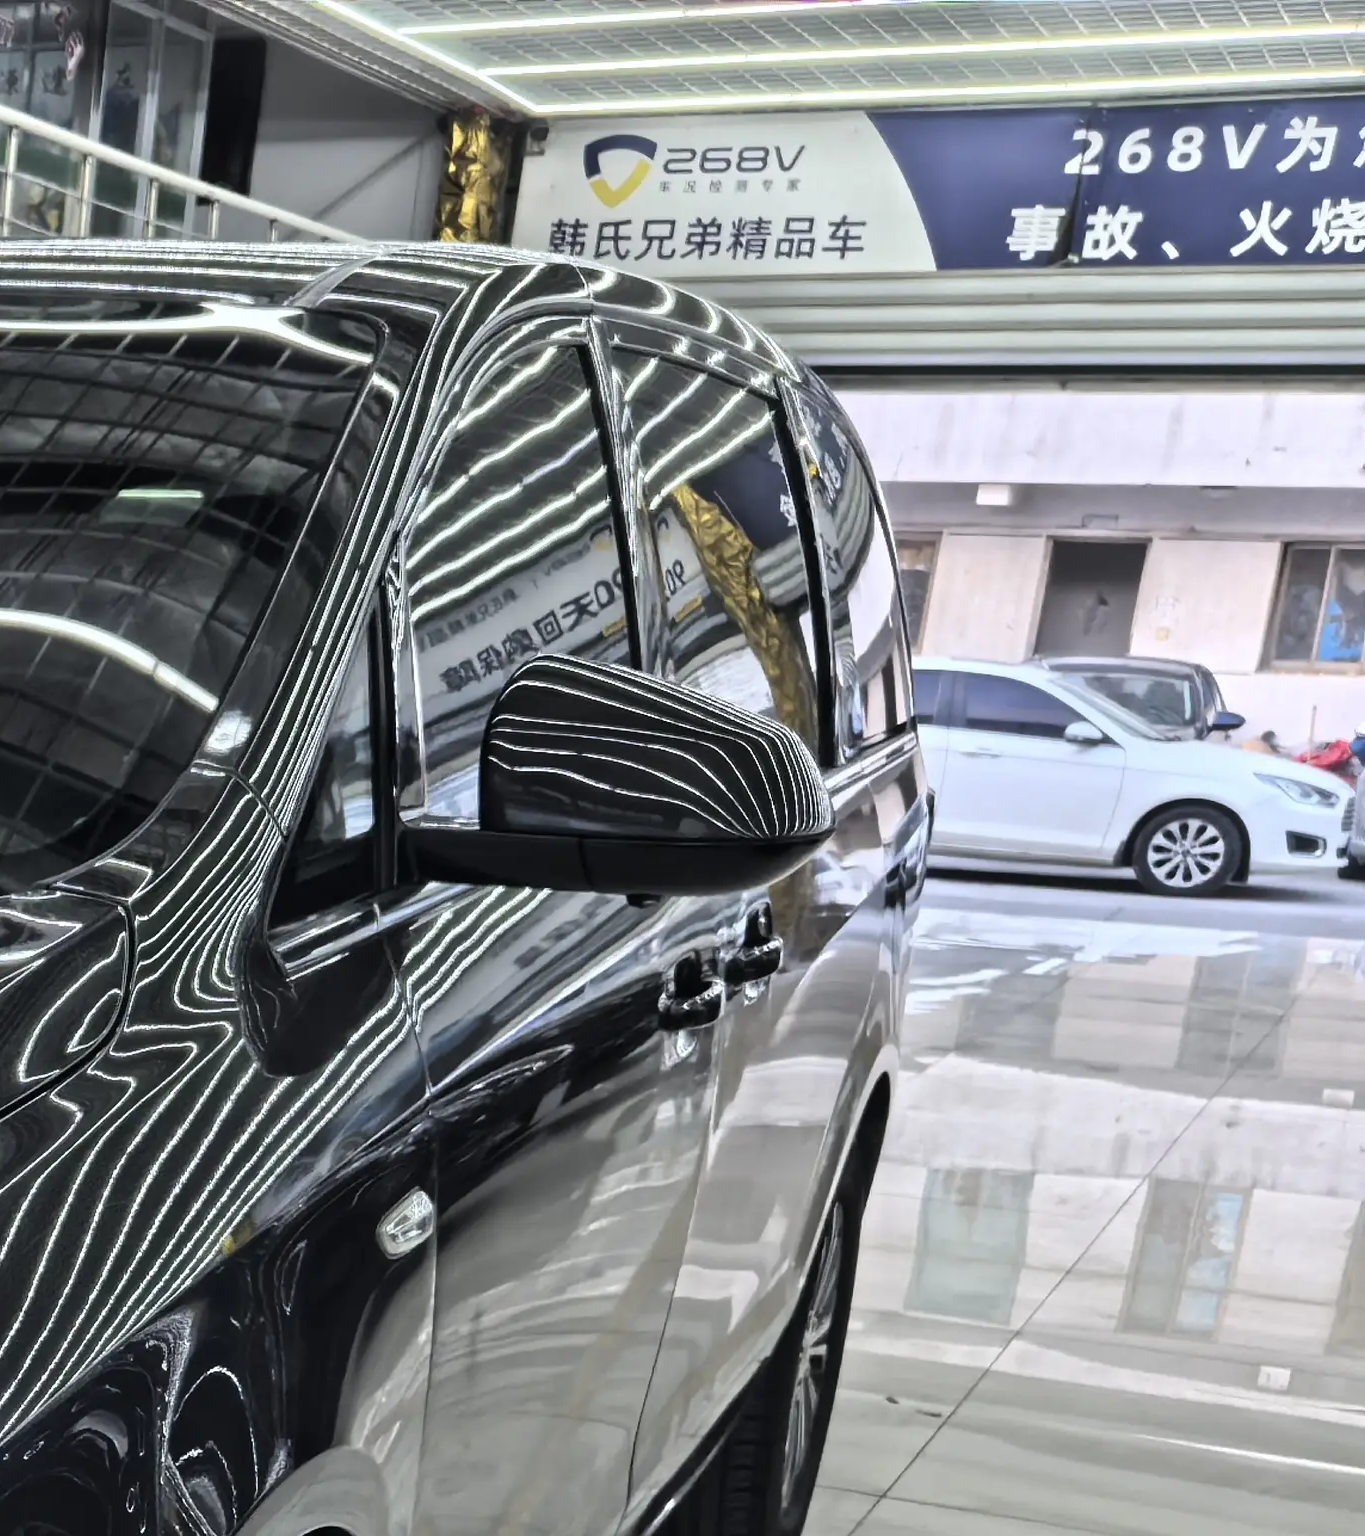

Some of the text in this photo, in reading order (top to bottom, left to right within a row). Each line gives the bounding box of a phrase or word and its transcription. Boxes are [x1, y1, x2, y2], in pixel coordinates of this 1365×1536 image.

[662, 144, 806, 174] 268V
[547, 214, 867, 261] 韩氏兄弟精品车
